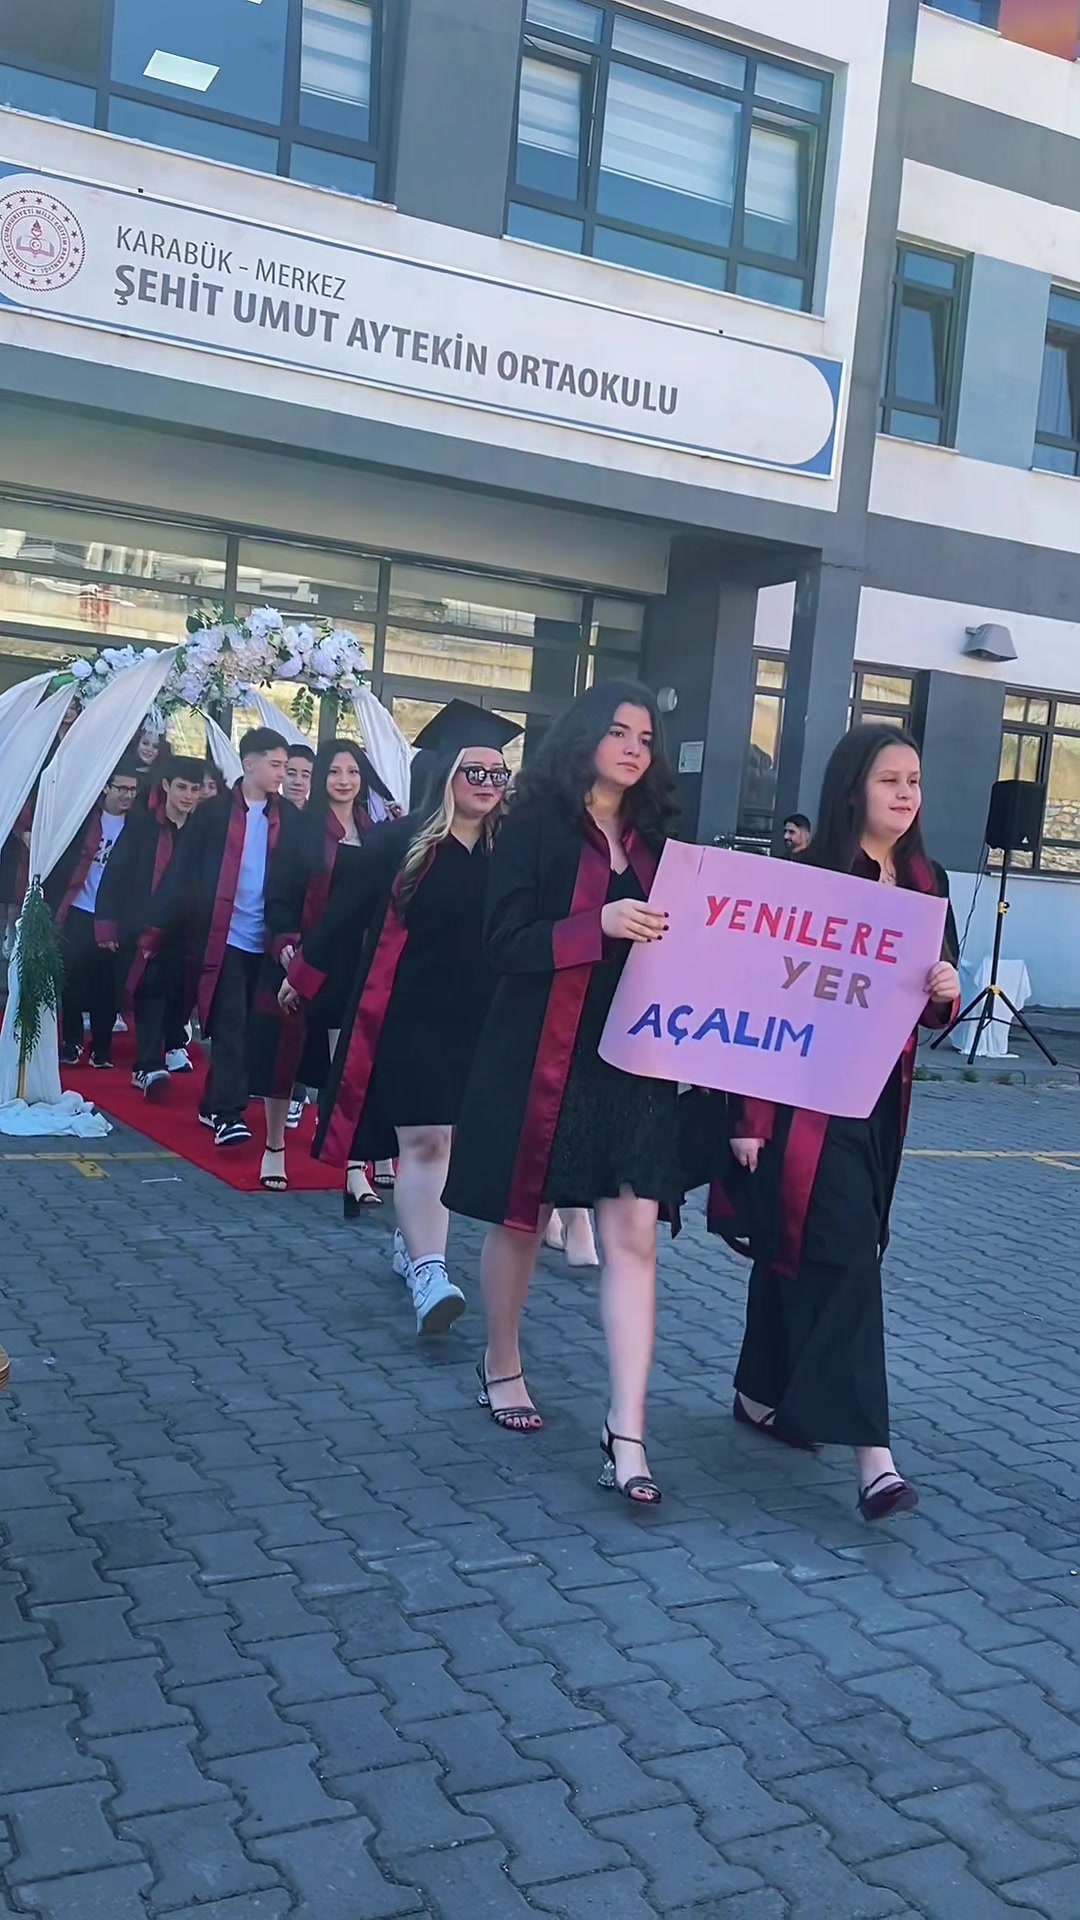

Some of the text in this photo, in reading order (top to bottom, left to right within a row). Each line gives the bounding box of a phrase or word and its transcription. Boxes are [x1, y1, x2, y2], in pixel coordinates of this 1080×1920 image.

[117, 226, 232, 274] KARABÜK
[256, 258, 346, 300] MERKEZ
[114, 264, 677, 414] ŞEHİT UMUT AYTEKİN ORTAOKULU
[706, 895, 903, 964] YENİLERE
[781, 956, 872, 1009] YER
[627, 1003, 814, 1057] AÇALIM
